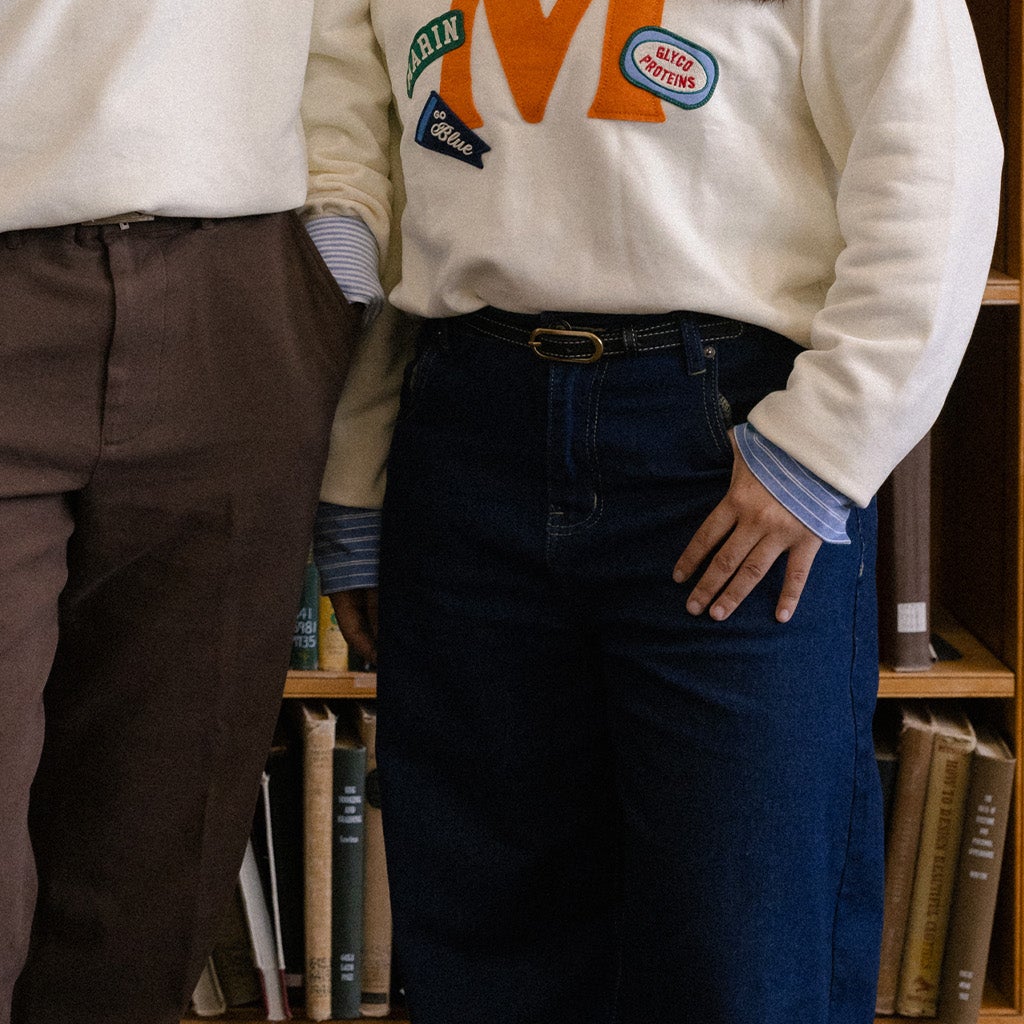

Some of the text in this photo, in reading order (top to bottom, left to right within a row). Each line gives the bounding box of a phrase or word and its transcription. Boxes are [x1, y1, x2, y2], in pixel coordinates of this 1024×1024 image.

[639, 54, 696, 89] PROTEINS
[655, 45, 695, 72] GLYCO
[433, 109, 446, 121] GO
[430, 121, 473, 156] Blue
